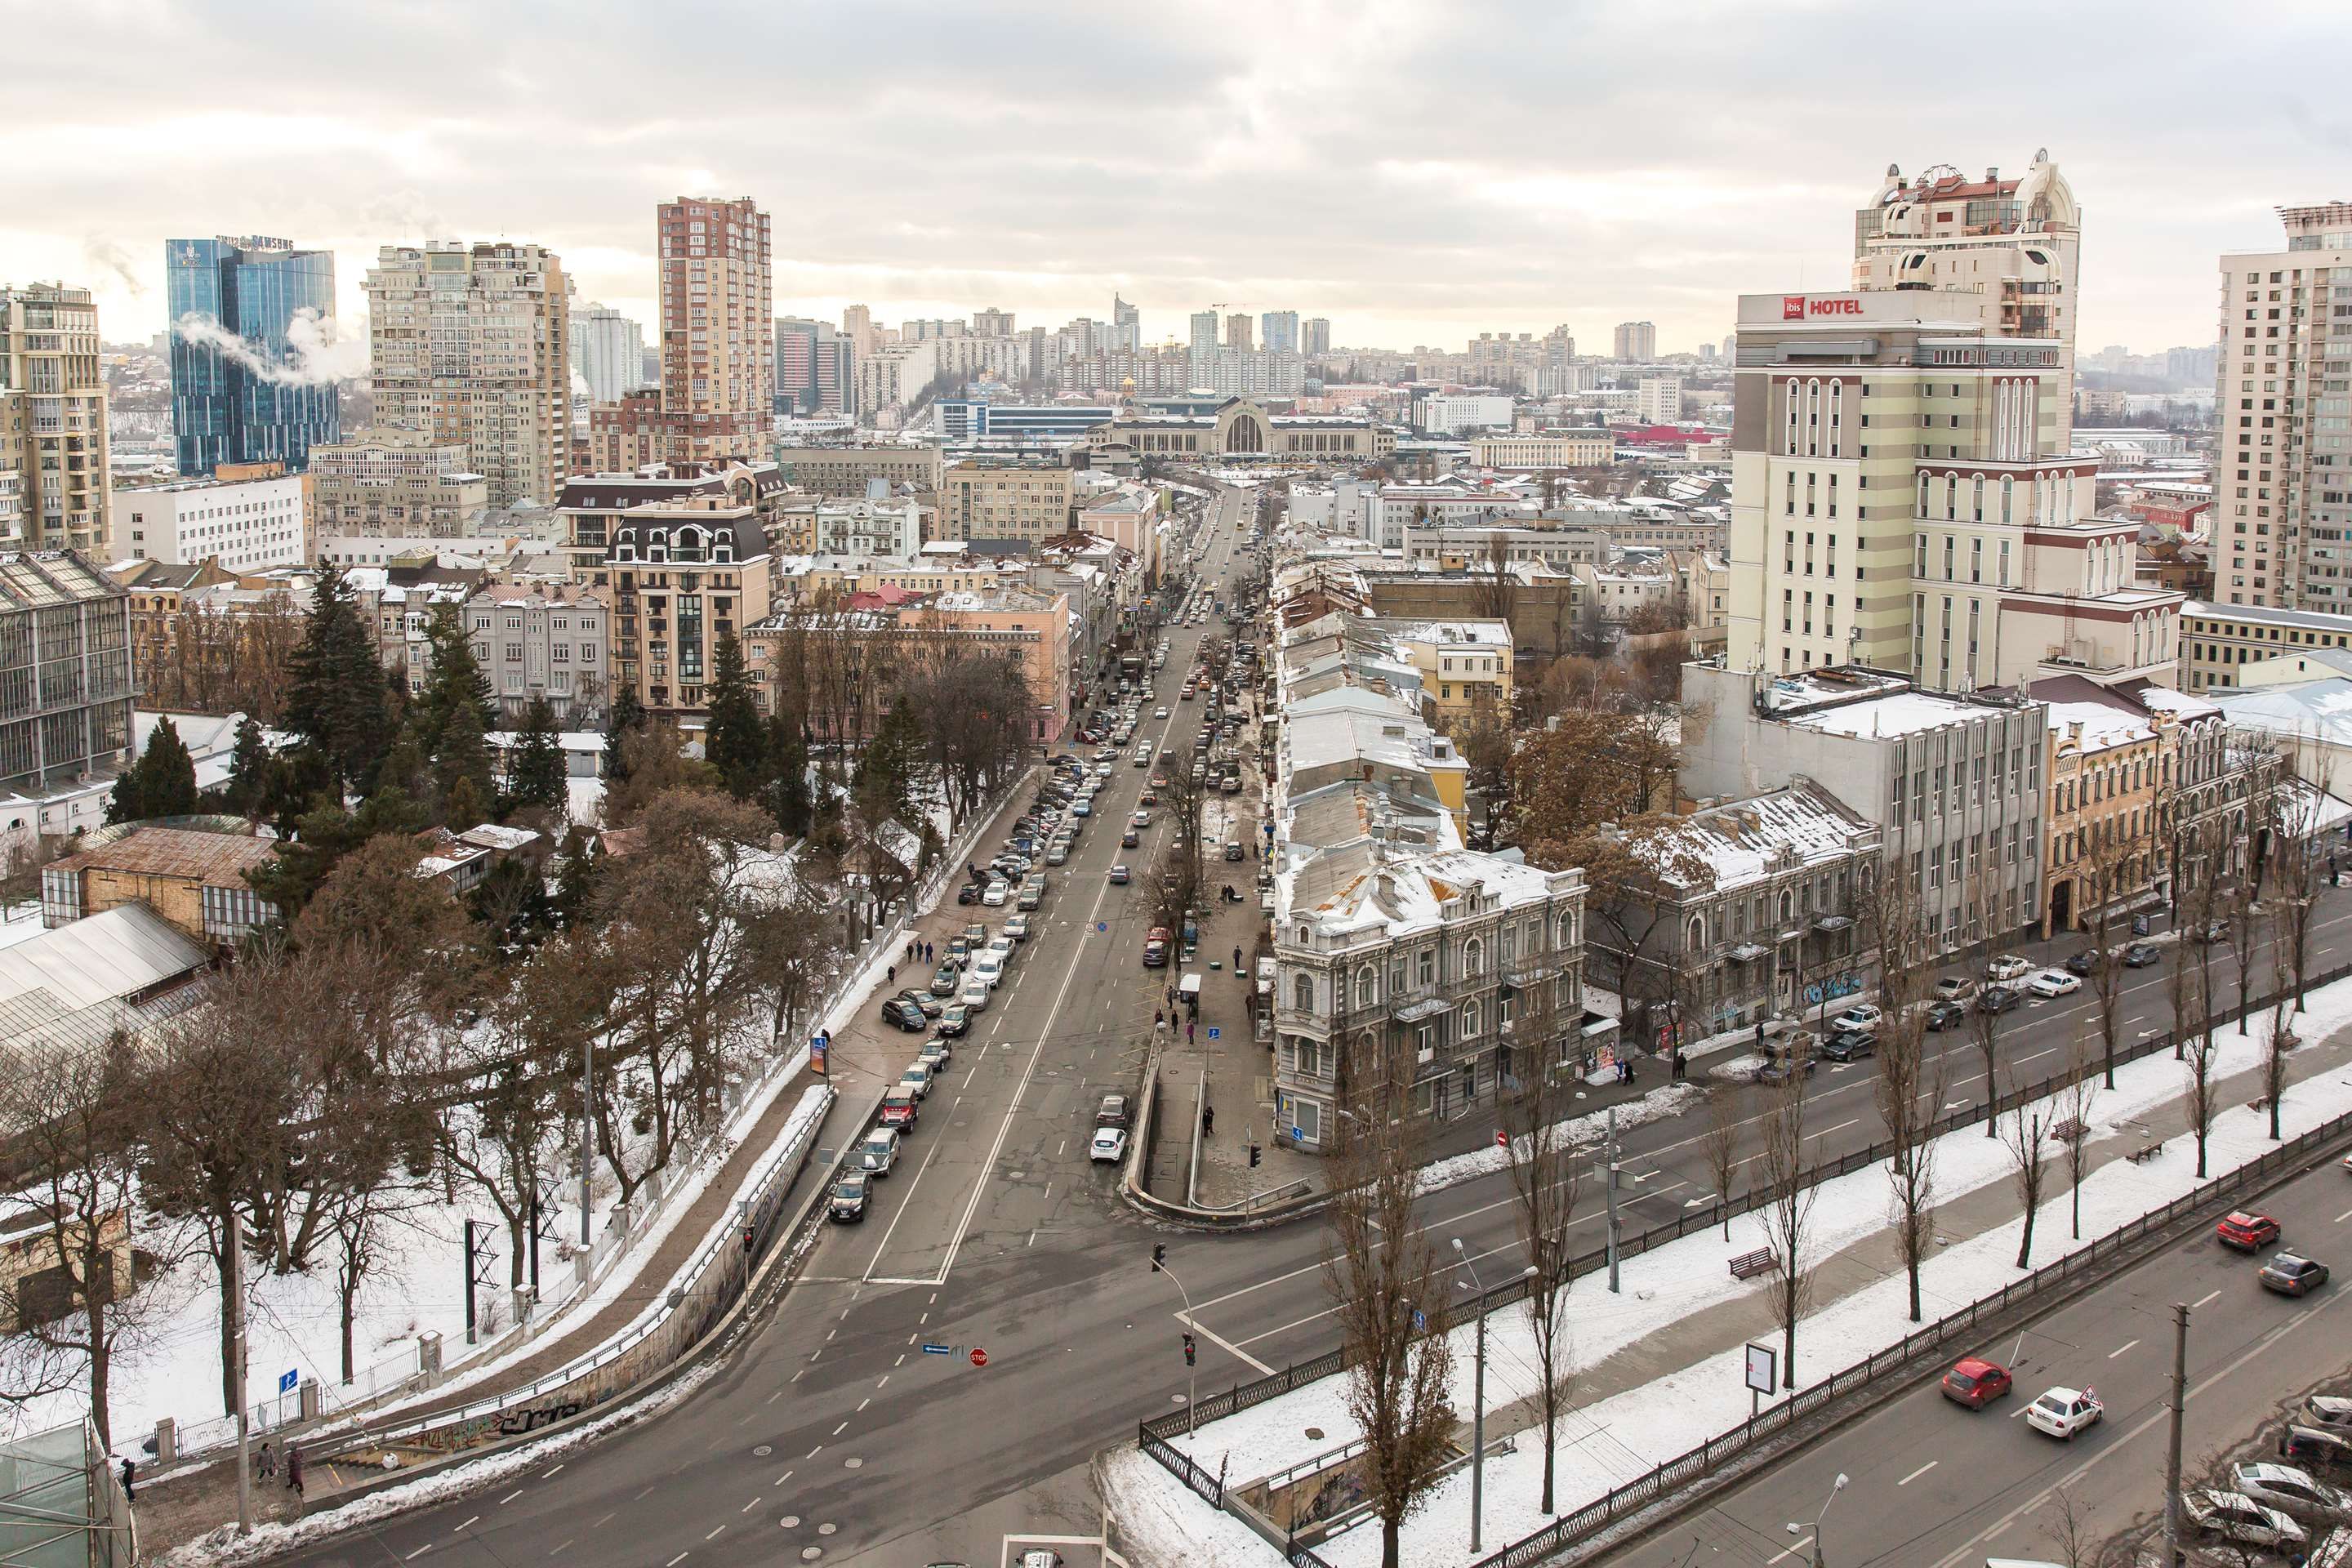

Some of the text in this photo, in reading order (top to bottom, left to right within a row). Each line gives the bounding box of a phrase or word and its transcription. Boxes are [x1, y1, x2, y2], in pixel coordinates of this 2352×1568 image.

[252, 235, 294, 250] SAMSUNG
[1786, 300, 1864, 314] ibis HOTEL
